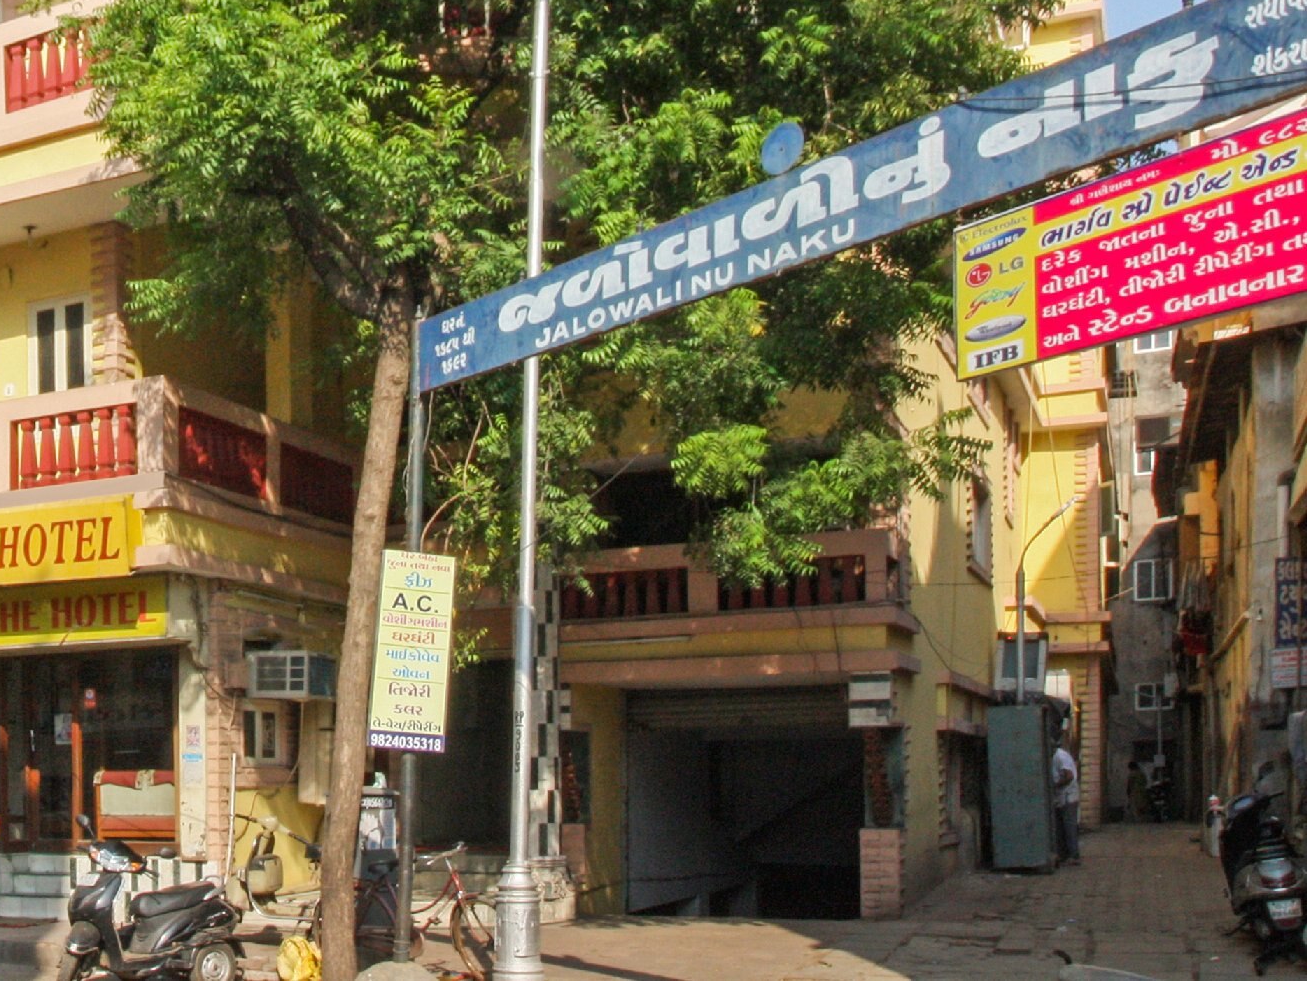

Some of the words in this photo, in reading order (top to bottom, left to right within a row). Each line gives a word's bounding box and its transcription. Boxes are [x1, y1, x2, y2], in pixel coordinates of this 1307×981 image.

[1210, 139, 1247, 158] મો.
[1041, 206, 1112, 247] ભાર્ગવ
[1241, 149, 1298, 179] એન્ડ
[1042, 249, 1082, 272] દરેક
[1099, 222, 1165, 252] જાતના
[1182, 201, 1234, 232] જુના
[1253, 179, 1304, 206] તથા
[747, 218, 855, 273] NAKU
[969, 233, 1019, 256] SAMSUNG
[999, 256, 1024, 274] LG
[1042, 264, 1109, 295] વોશીંગ
[1124, 241, 1196, 269] મશીન,
[1042, 286, 1111, 318] ઘરઘંટી,
[1119, 263, 1186, 297] તીજોરી
[1193, 241, 1274, 276] રીપેરીંગ
[1043, 324, 1081, 348] અને
[1088, 305, 1153, 336] સ્ટેન્ડ
[1164, 264, 1304, 314] બનાવનાર
[974, 344, 1019, 369] IFB
[50, 590, 157, 628] HOTEL
[392, 593, 438, 613] A.C.
[392, 631, 435, 644] ઘરઘંટી
[388, 682, 430, 698] તિજોરી
[393, 704, 423, 715] કલર
[371, 733, 441, 751] 9824035318
